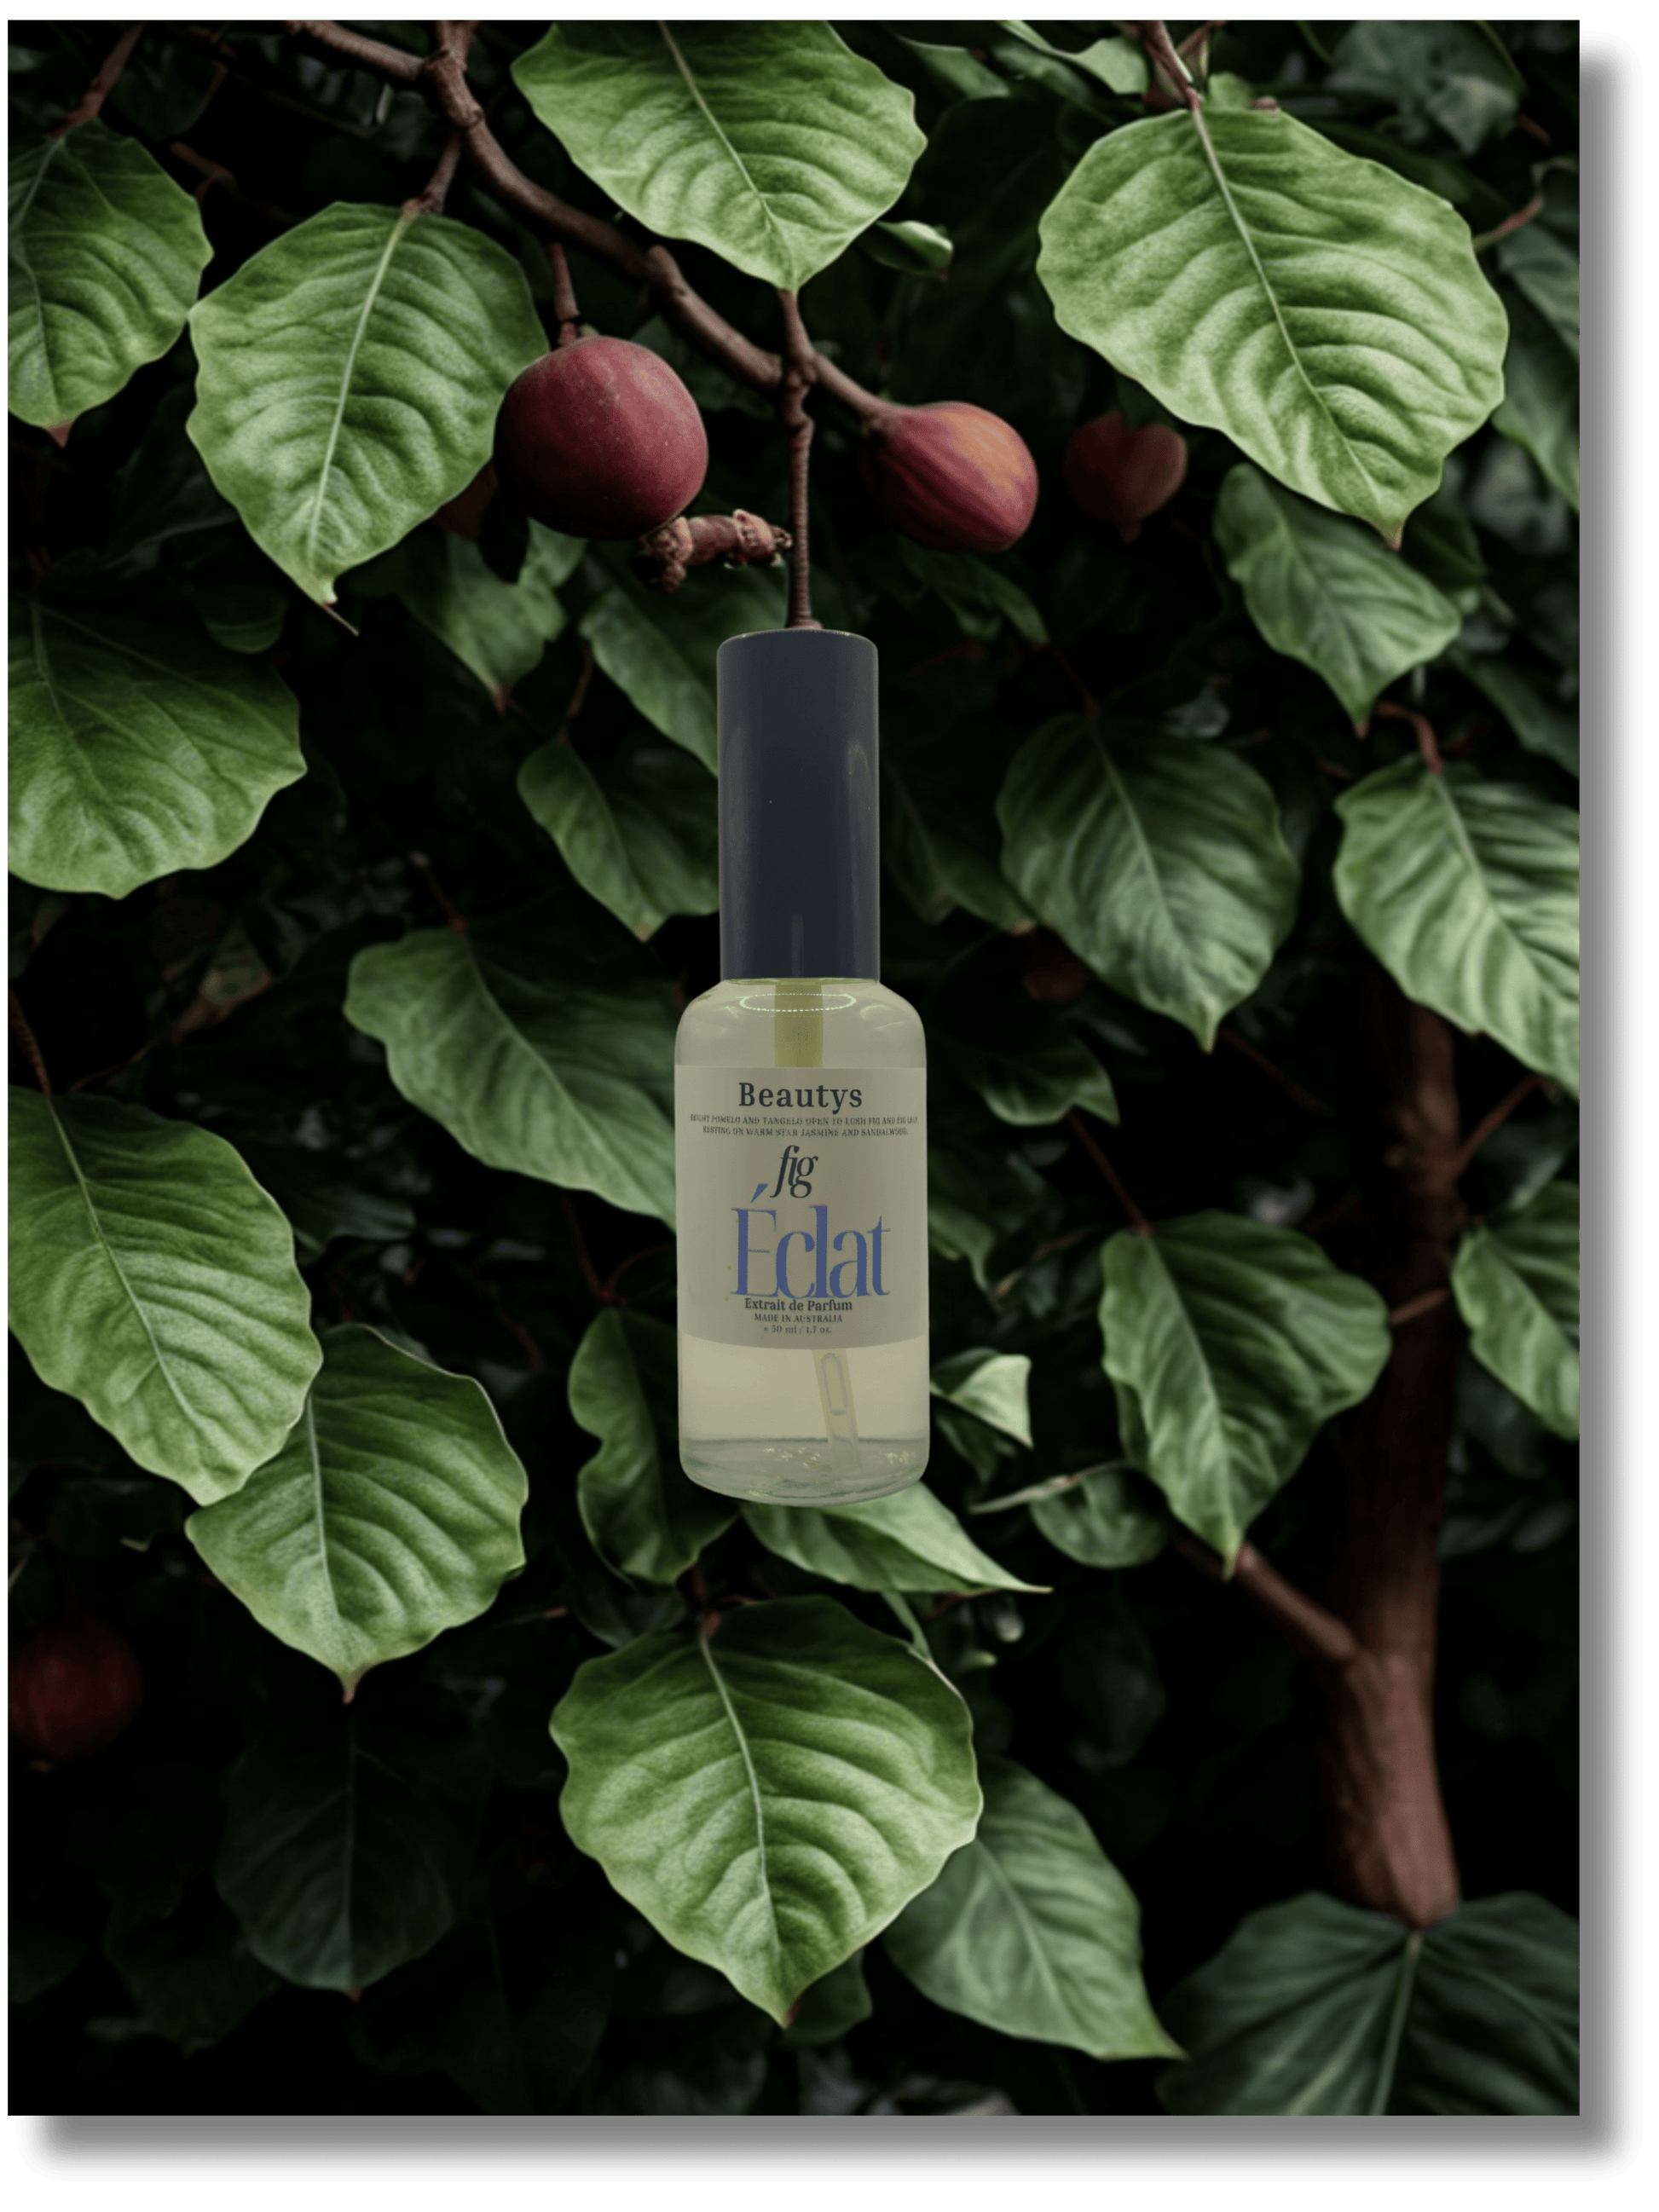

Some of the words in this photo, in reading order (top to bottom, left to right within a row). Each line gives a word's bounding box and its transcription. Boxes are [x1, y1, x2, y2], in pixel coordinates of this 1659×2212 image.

[738, 1081, 863, 1115] Beautys
[711, 1115, 740, 1124] POMELO
[743, 1116, 760, 1125] AND
[763, 1117, 802, 1126] TANGELO
[805, 1117, 829, 1125] OPEN
[831, 1117, 843, 1125] TO
[845, 1117, 866, 1125] LUSH
[868, 1117, 881, 1125] FIG
[882, 1117, 896, 1125] AND
[897, 1116, 906, 1124] FIG
[702, 1125, 731, 1135] RESTING
[733, 1127, 744, 1135] ON
[746, 1128, 773, 1136] WARM
[775, 1128, 798, 1136] STAR
[801, 1128, 839, 1136] JASMINE
[841, 1128, 859, 1136] AND
[769, 1145, 818, 1198] fig
[731, 1182, 891, 1298] Éclat
[744, 1297, 786, 1311] Extrait
[789, 1300, 804, 1311] de
[806, 1299, 853, 1311] Parfum
[754, 1313, 779, 1322] MADE
[782, 1314, 791, 1322] IN
[794, 1314, 843, 1323] AUSTRALIA
[771, 1324, 783, 1334] 50
[784, 1325, 797, 1334] ml
[806, 1325, 818, 1334] 1.7
[819, 1325, 832, 1334] oz.
